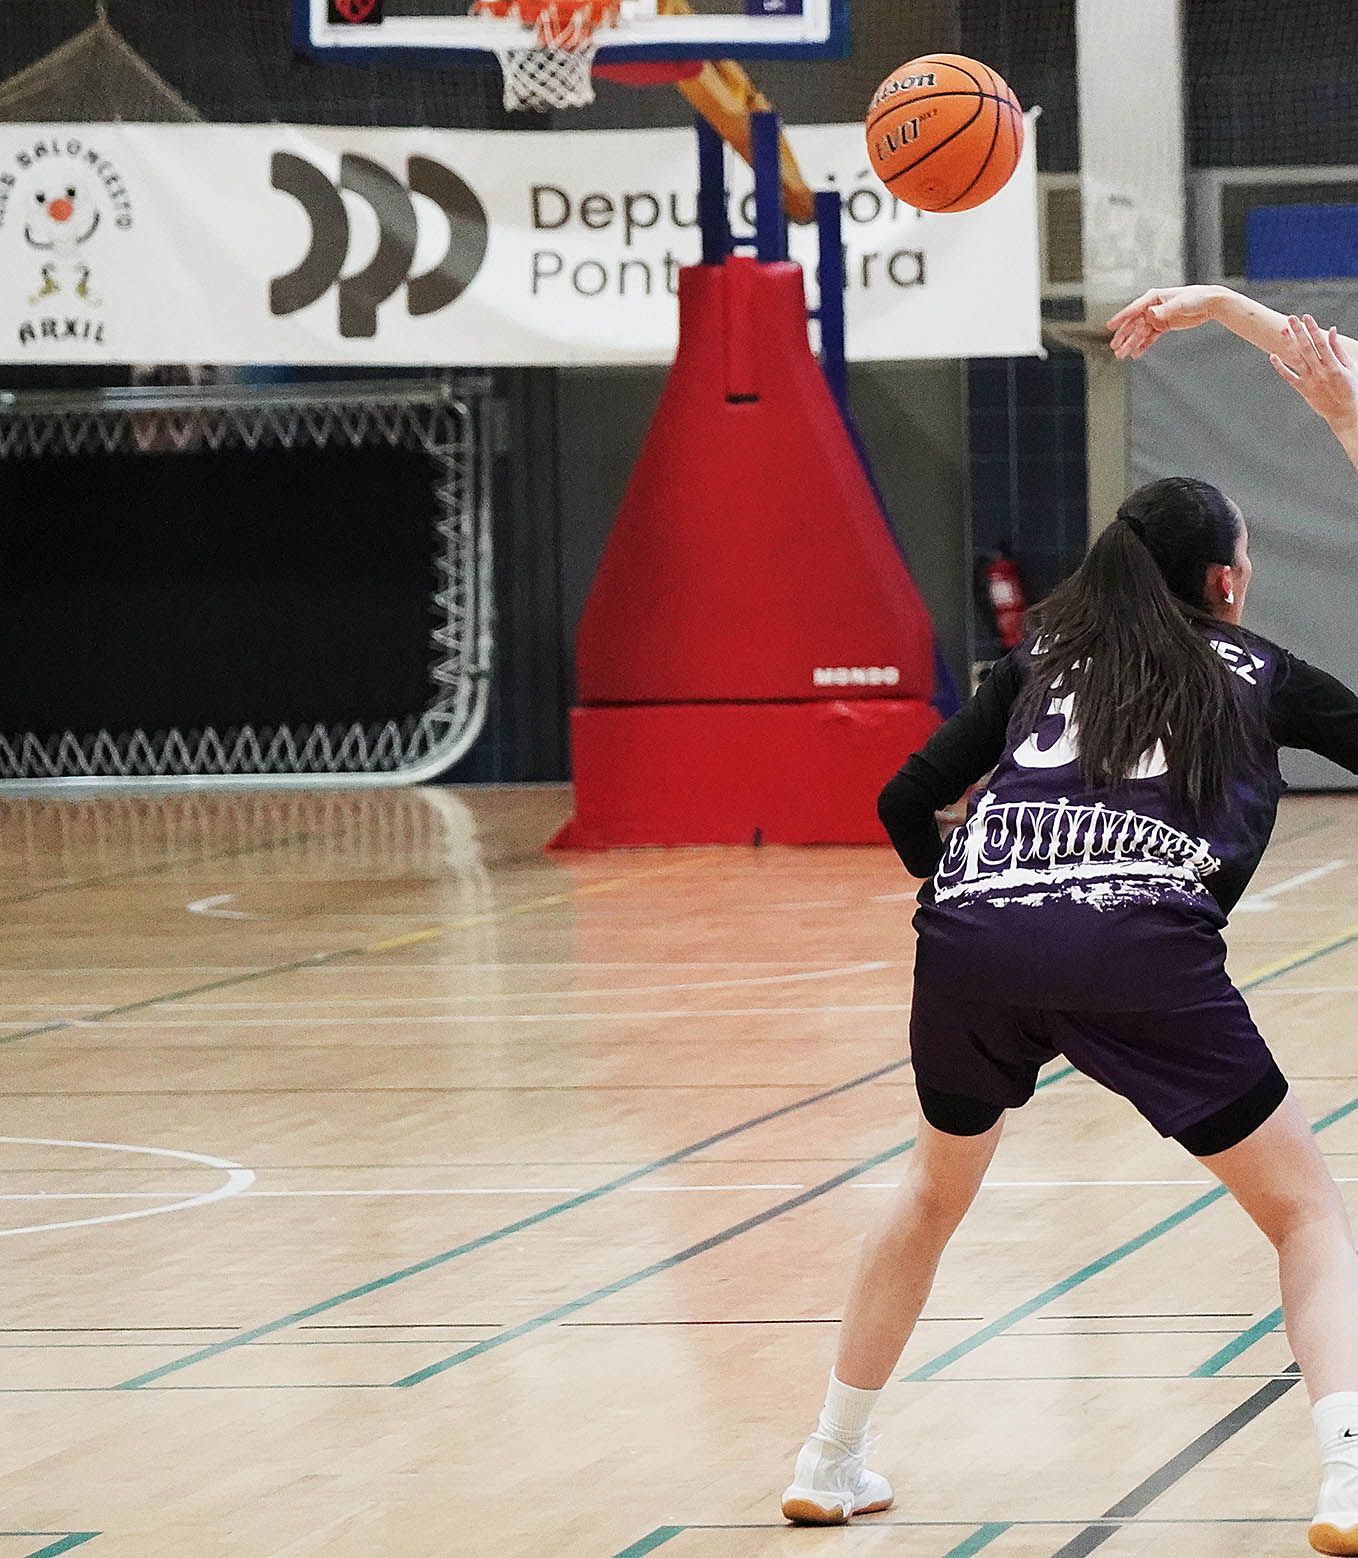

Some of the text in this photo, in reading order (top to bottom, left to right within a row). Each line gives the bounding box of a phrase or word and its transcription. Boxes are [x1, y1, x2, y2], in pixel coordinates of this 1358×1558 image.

[531, 170, 923, 246] Depuón
[532, 248, 926, 297] Pontra
[19, 316, 105, 346] ARXIL
[813, 666, 899, 687] MONDO
